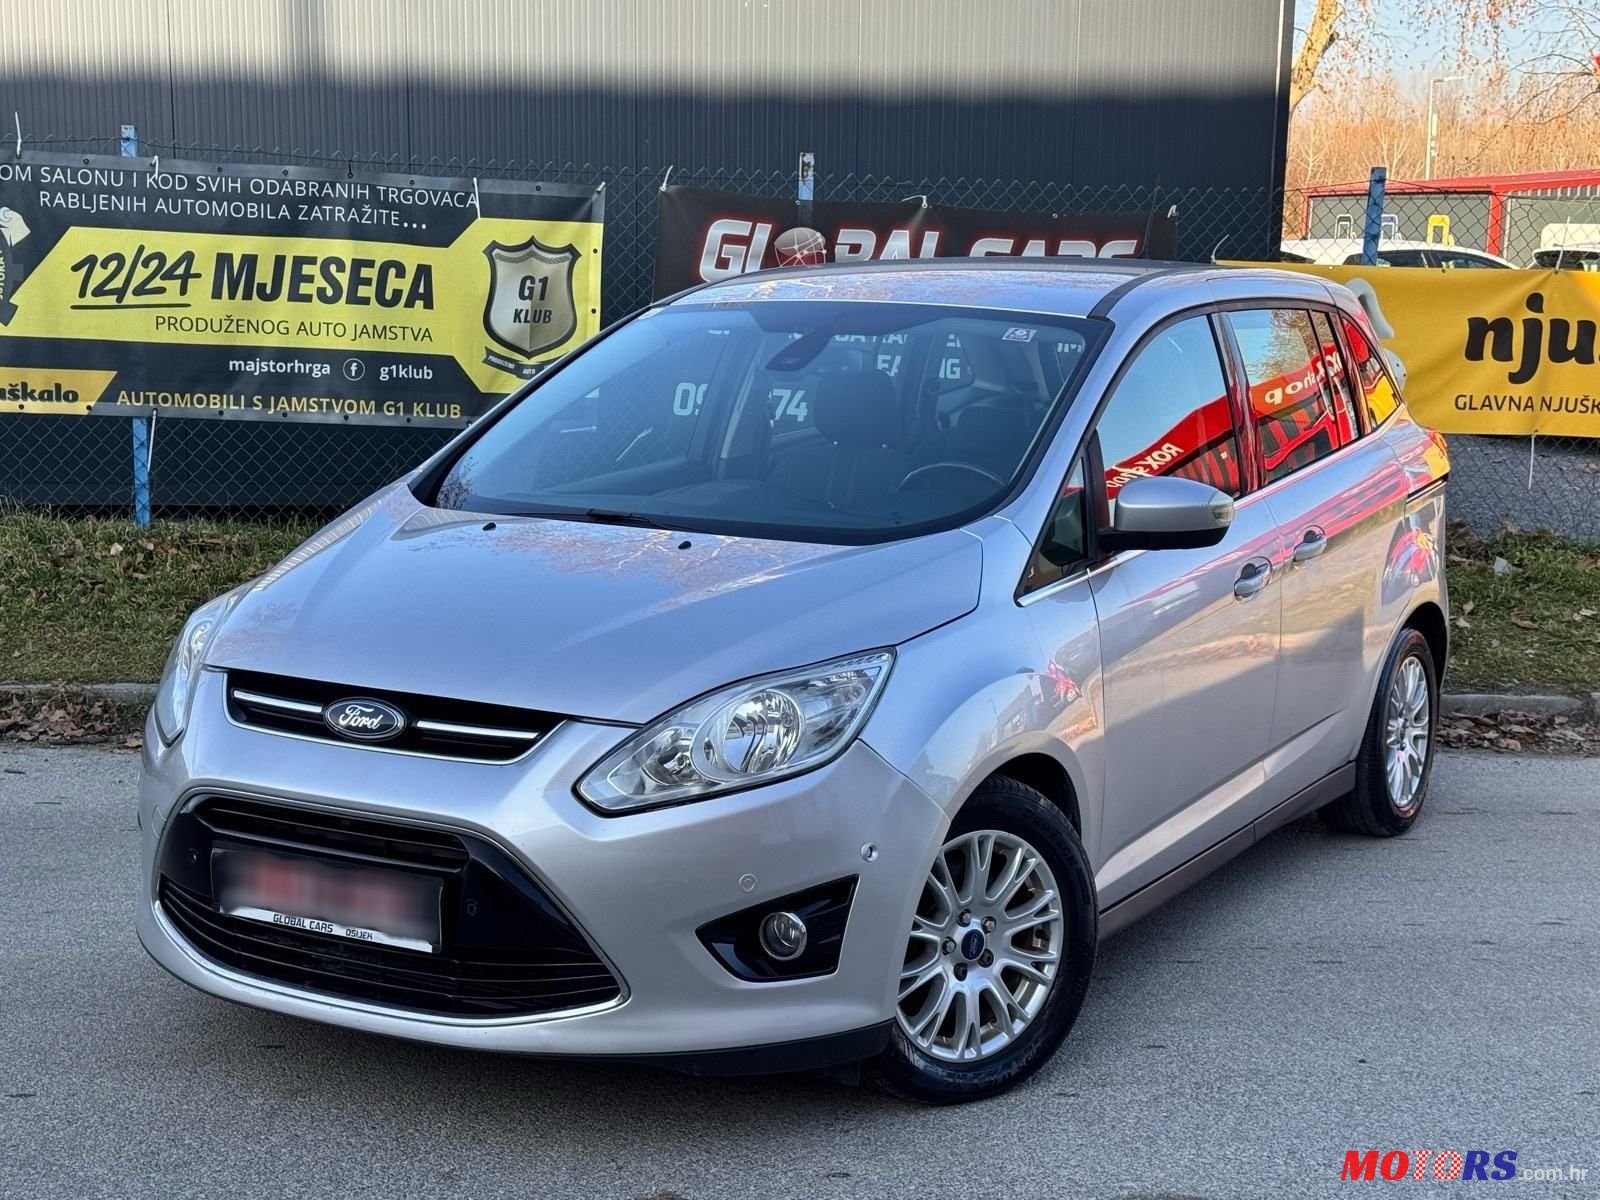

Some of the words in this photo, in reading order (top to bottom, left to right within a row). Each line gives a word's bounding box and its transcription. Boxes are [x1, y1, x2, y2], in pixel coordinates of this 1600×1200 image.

[0, 165, 32, 182] OM
[40, 167, 125, 187] SALONU
[132, 172, 137, 187] I
[146, 172, 188, 191] KOD
[196, 175, 241, 193] SVIH
[250, 178, 370, 200] ODABRANIH
[376, 186, 479, 208] TRGOVACA
[40, 191, 146, 213] RABLJENIH
[155, 198, 291, 220] AUTOMOBILA
[70, 244, 202, 303] 12/24
[210, 252, 434, 310] MJESECA
[518, 274, 550, 301] G1
[155, 315, 290, 336] PRODUŽENOG
[296, 322, 347, 338] AUTO
[352, 323, 433, 343] JAMSTVA
[513, 308, 553, 325] KLUB
[1464, 292, 1600, 385] nju
[229, 358, 331, 378] majstorhrga
[379, 365, 433, 380] g1klub
[117, 390, 245, 410] AUTOMOBILI
[252, 396, 263, 411] S
[268, 396, 375, 416] JAMSTVOM
[383, 401, 404, 416] G1
[413, 402, 461, 418] KLUB
[1454, 394, 1534, 412] GLAVNA
[339, 704, 384, 730] Ford
[273, 913, 307, 929] GLOBAL
[309, 920, 334, 933] CARS
[345, 928, 373, 940] OSIJEK
